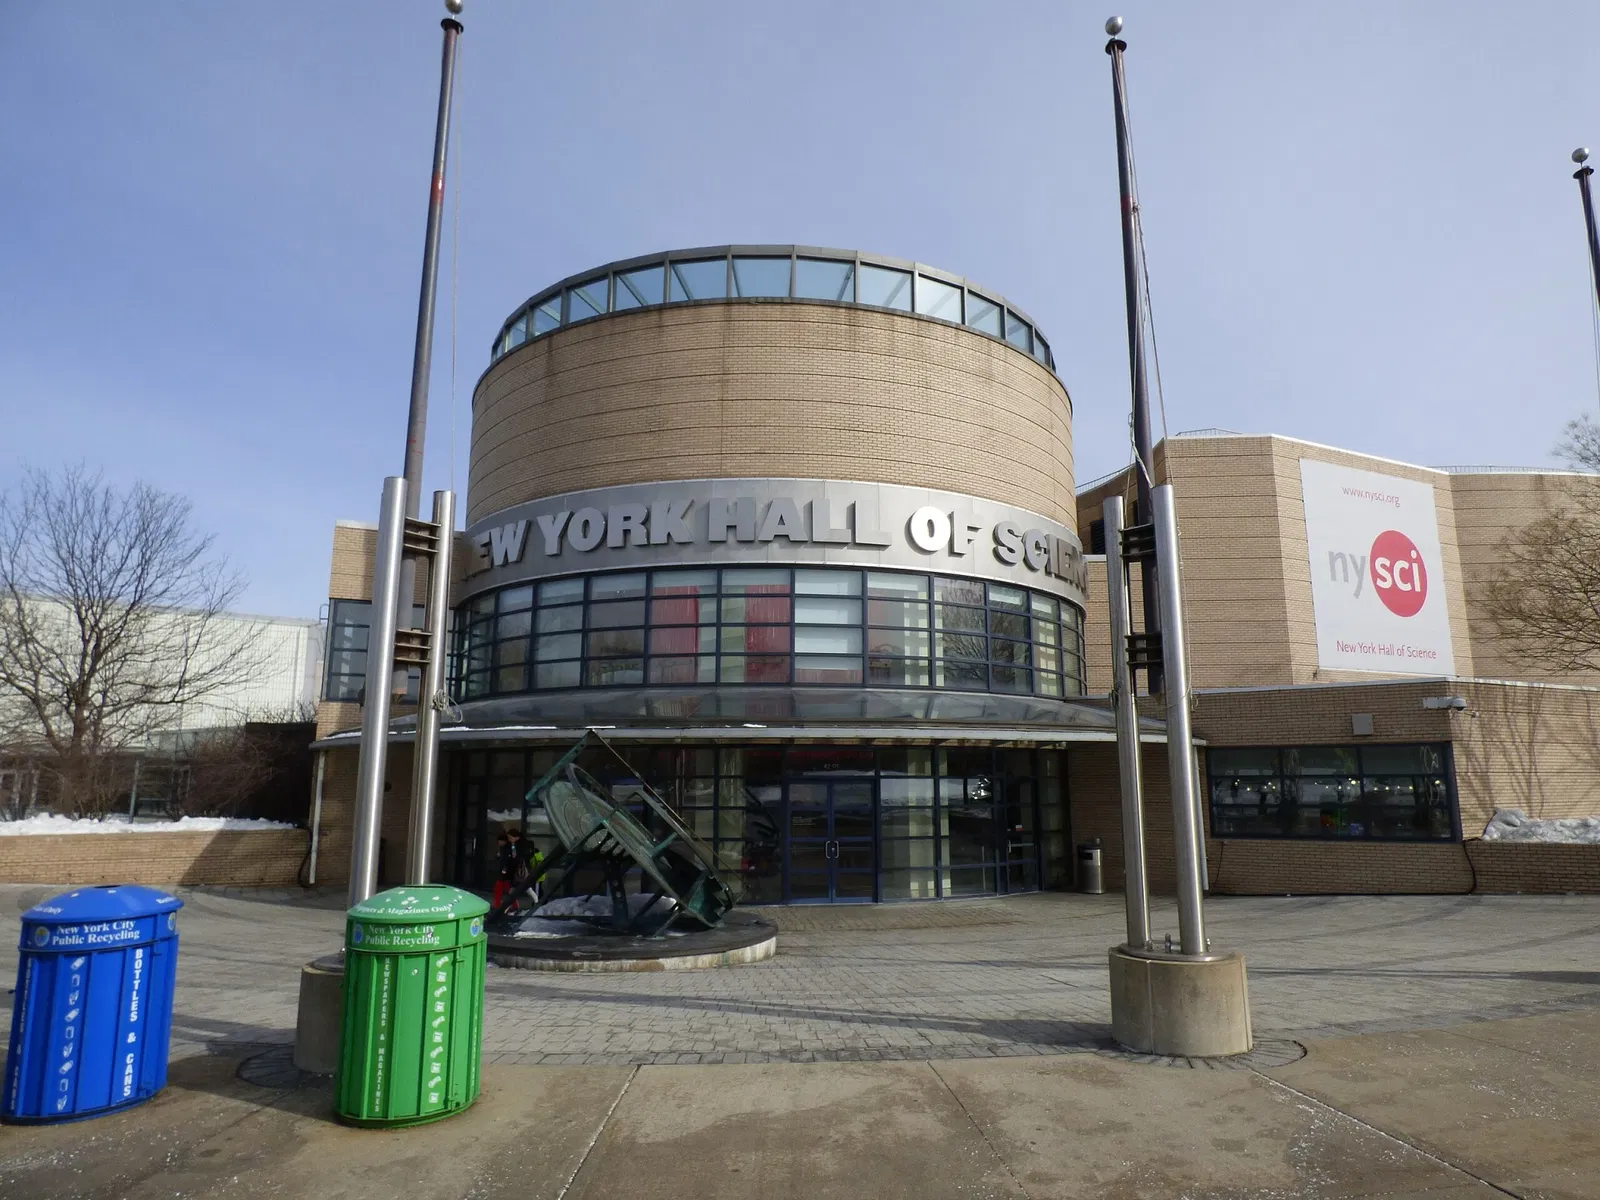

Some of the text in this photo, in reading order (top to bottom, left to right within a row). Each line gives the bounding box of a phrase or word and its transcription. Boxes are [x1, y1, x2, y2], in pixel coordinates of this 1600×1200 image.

[1341, 486, 1400, 507] www.nysci.org
[537, 499, 695, 556] YORK
[708, 497, 892, 547] HALL
[907, 506, 983, 558] OF
[1336, 640, 1437, 659] New York Hall of Science
[387, 907, 430, 915] Magazines
[56, 920, 137, 935] New York City
[368, 924, 437, 935] New York City
[52, 929, 141, 946] Public Recycling
[365, 935, 440, 947] Public Recycling
[381, 957, 389, 1027] NEWSPAPERS
[123, 949, 143, 1097] BOTTLES & CANS
[374, 1048, 385, 1113] MAGAZINES
